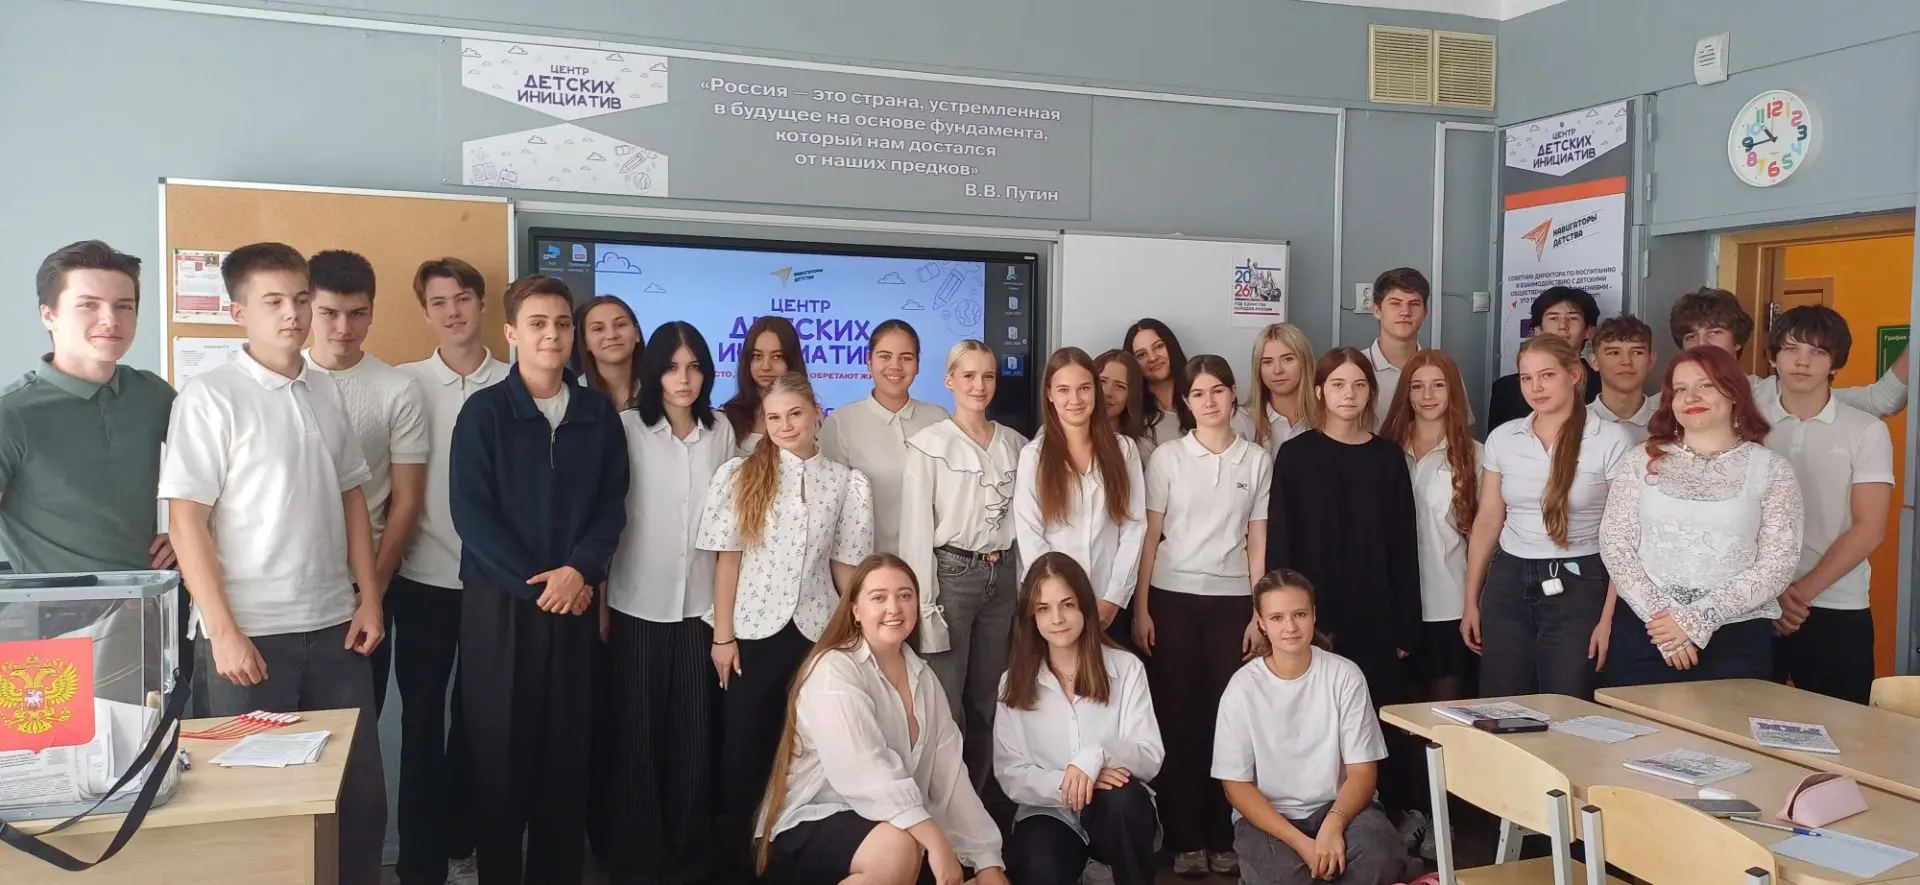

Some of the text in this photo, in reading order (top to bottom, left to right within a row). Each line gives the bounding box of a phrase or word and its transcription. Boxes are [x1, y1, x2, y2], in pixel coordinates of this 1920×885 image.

[550, 64, 589, 75] ЦЕНТР
[524, 74, 615, 94] ДЕТСКИХ
[517, 89, 622, 109] ИНИЦИАТИВ
[700, 77, 788, 98] «Россия
[812, 89, 847, 103] это
[851, 92, 924, 111] страна,
[929, 99, 1061, 121] устремленная
[1756, 108, 1765, 123] 11
[1767, 100, 1783, 119] 12
[1786, 102, 1791, 119] 1
[714, 101, 1048, 142] в будущее на основе фундамента,
[1791, 110, 1803, 127] 2
[1552, 128, 1576, 139] ЦЕНТР
[1746, 123, 1760, 137] 10
[1797, 124, 1807, 141] 3
[776, 129, 996, 157] который нам достался
[1537, 134, 1592, 156] ДЕТСКИХ
[1742, 136, 1754, 153] 9
[1791, 141, 1801, 156] 4
[794, 153, 978, 176] от наших предков»
[1533, 148, 1596, 169] ИНИЦИАТИВ
[1747, 151, 1757, 167] 8
[1782, 153, 1794, 170] 5
[1757, 159, 1767, 176] 7
[1768, 161, 1780, 177] 6
[965, 183, 1059, 202] В.В. Путин
[1553, 213, 1597, 237] НАВИГАТОРЫ
[1553, 229, 1583, 248] ДЕТСТВА
[1235, 270, 1251, 283] 20
[1535, 271, 1566, 280] ДИРЕКТОРА
[1576, 266, 1616, 275] ВОСПИТАНИЮ
[1576, 275, 1607, 284] ДЕТСКИМИ
[1235, 284, 1250, 297] 26
[771, 298, 831, 313] ЦЕНТР
[729, 316, 870, 342] ДСКИХ
[810, 372, 859, 380] ОБРЕТАЮТ
